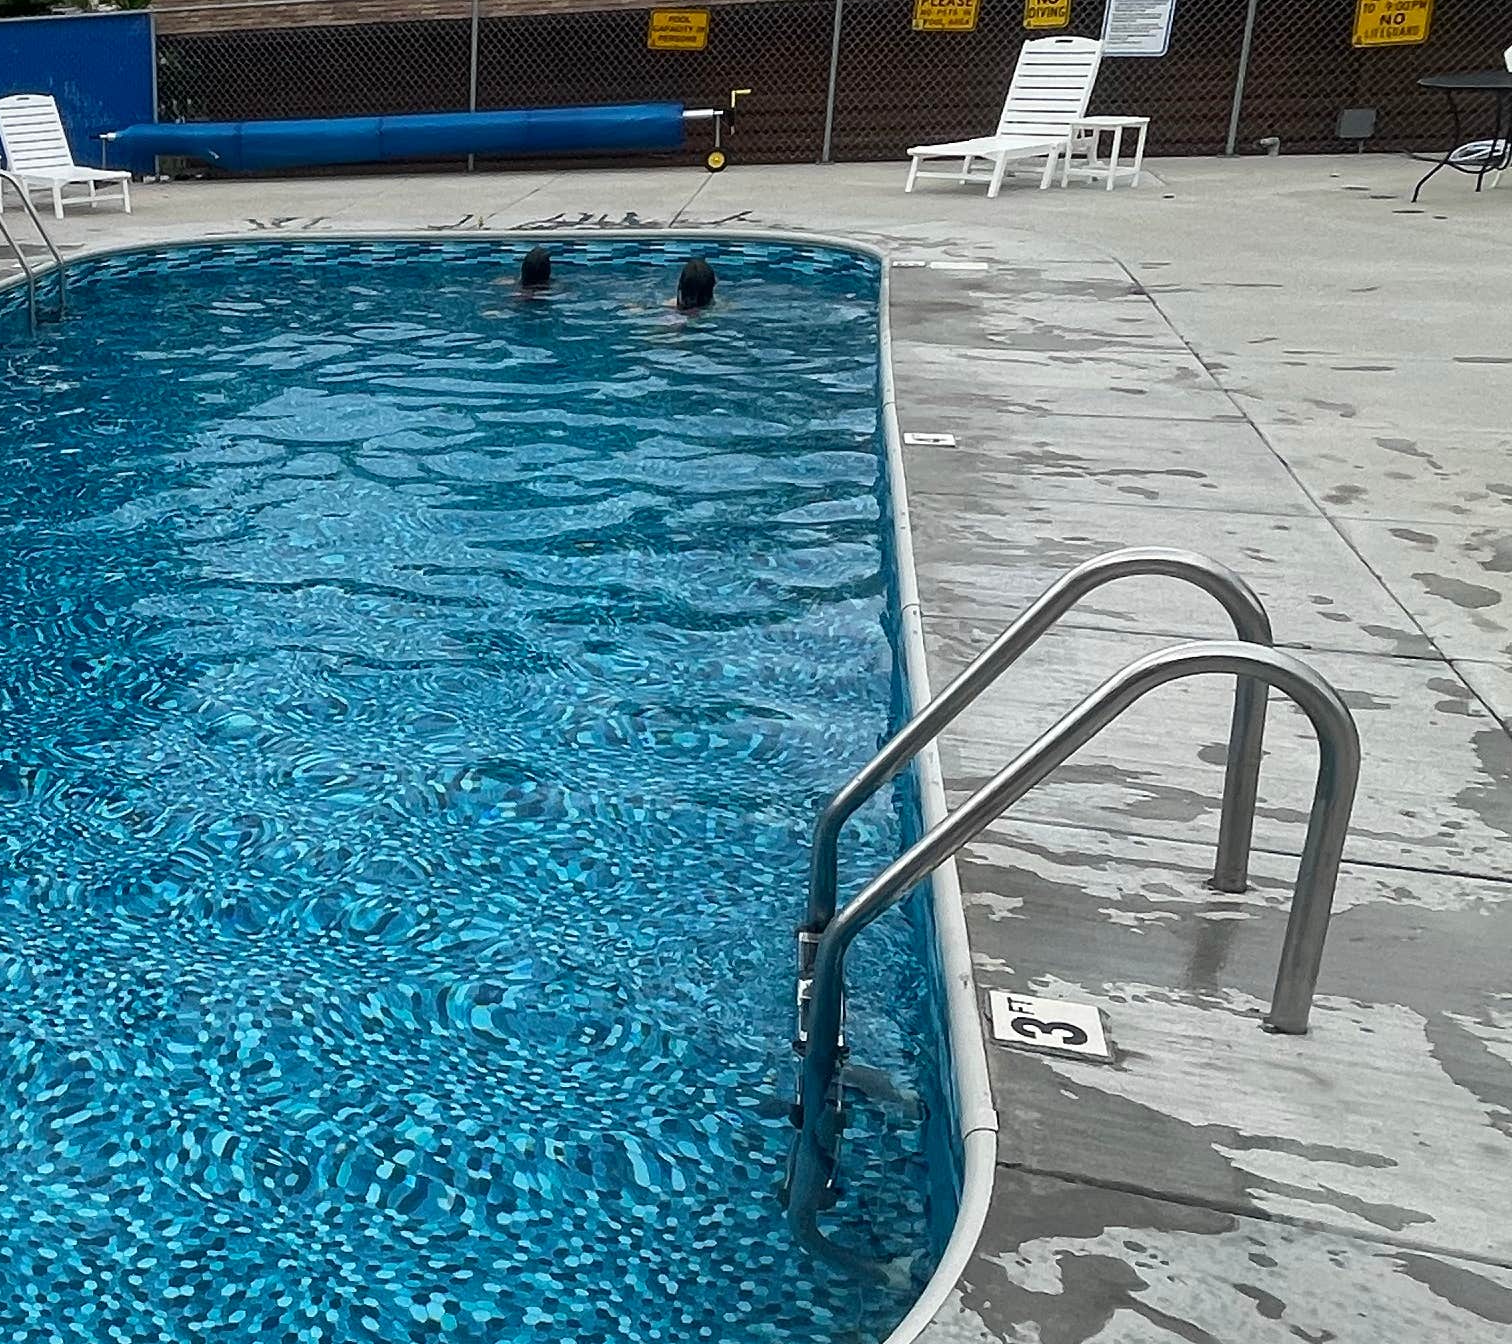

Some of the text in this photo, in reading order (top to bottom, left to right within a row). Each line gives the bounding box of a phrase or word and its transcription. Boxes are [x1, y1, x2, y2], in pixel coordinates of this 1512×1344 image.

[1028, 6, 1066, 18] DIVING
[1379, 12, 1406, 25] NO
[1011, 1017, 1088, 1045] 3
